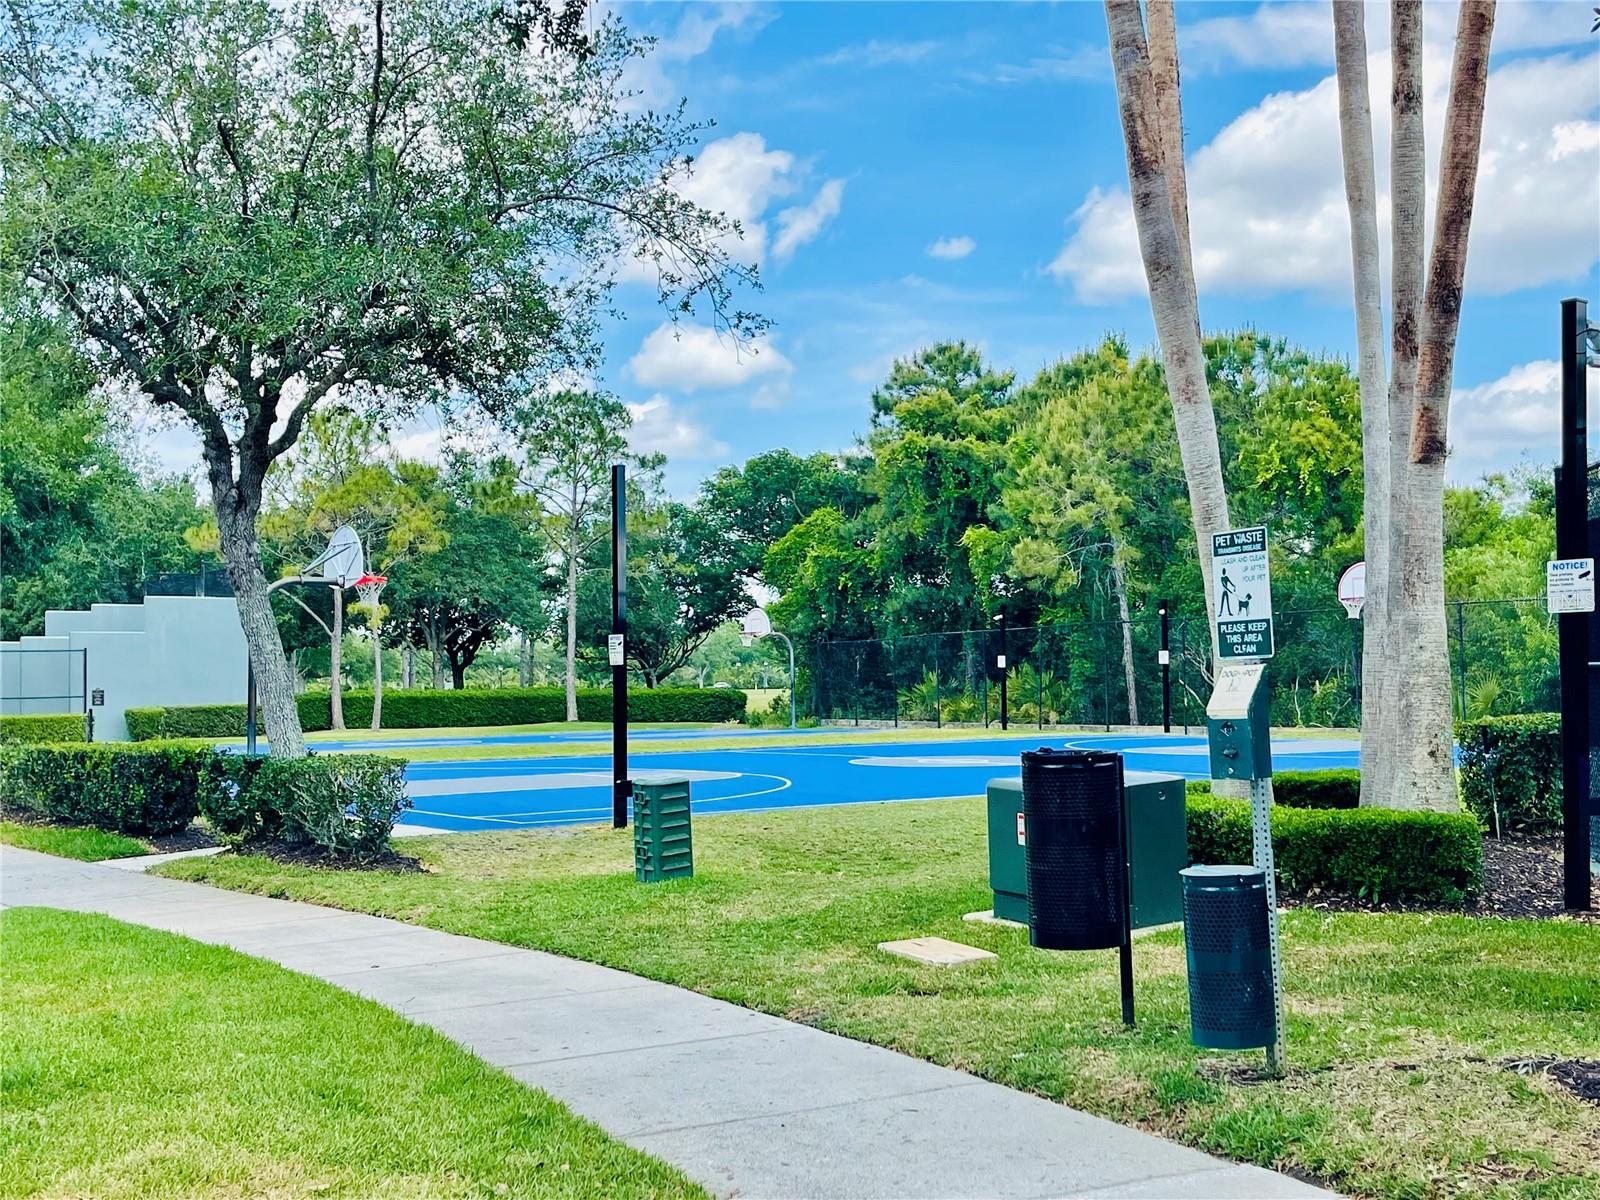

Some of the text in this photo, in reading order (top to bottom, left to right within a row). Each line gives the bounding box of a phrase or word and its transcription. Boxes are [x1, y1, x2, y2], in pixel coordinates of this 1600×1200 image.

[1215, 531, 1263, 547] PET WASTE
[1242, 543, 1262, 552] DISEASE
[1249, 554, 1266, 562] CLEAN
[1552, 561, 1588, 571] NOTICE!
[1257, 573, 1266, 581] PET
[1220, 622, 1267, 633] PLEASE KEEP
[1226, 633, 1263, 643] THIS AREA
[1233, 644, 1257, 654] CLEAN
